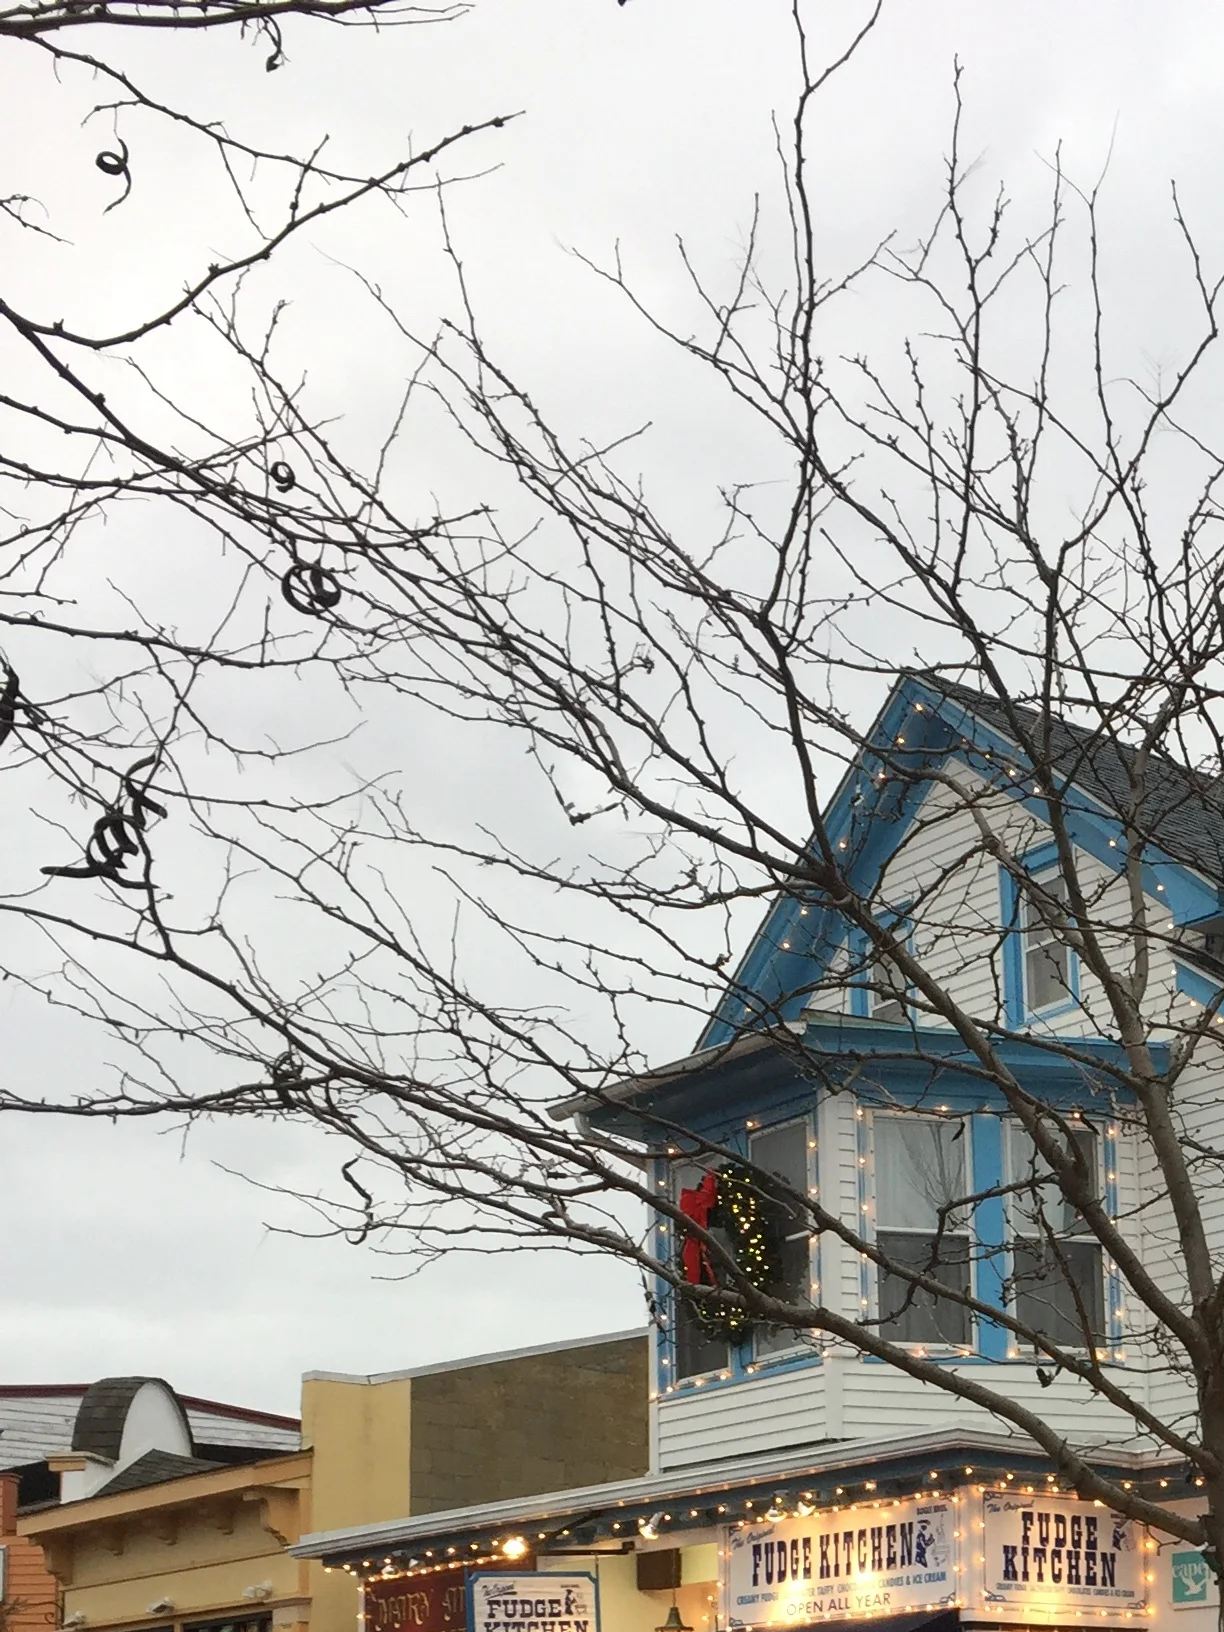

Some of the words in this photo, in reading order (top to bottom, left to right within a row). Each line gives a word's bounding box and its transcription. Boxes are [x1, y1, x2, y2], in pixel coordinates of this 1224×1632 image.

[987, 1503, 1001, 1513] The
[1021, 1511, 1098, 1550] FUDGE
[752, 1537, 812, 1587] FUDGE
[819, 1521, 914, 1580] KITCHEN
[1002, 1545, 1116, 1587] KITCHEN
[487, 1599, 561, 1618] FUDGE
[786, 1599, 823, 1616] OPEN
[827, 1598, 850, 1611] ALL
[855, 1593, 891, 1607] YEAR
